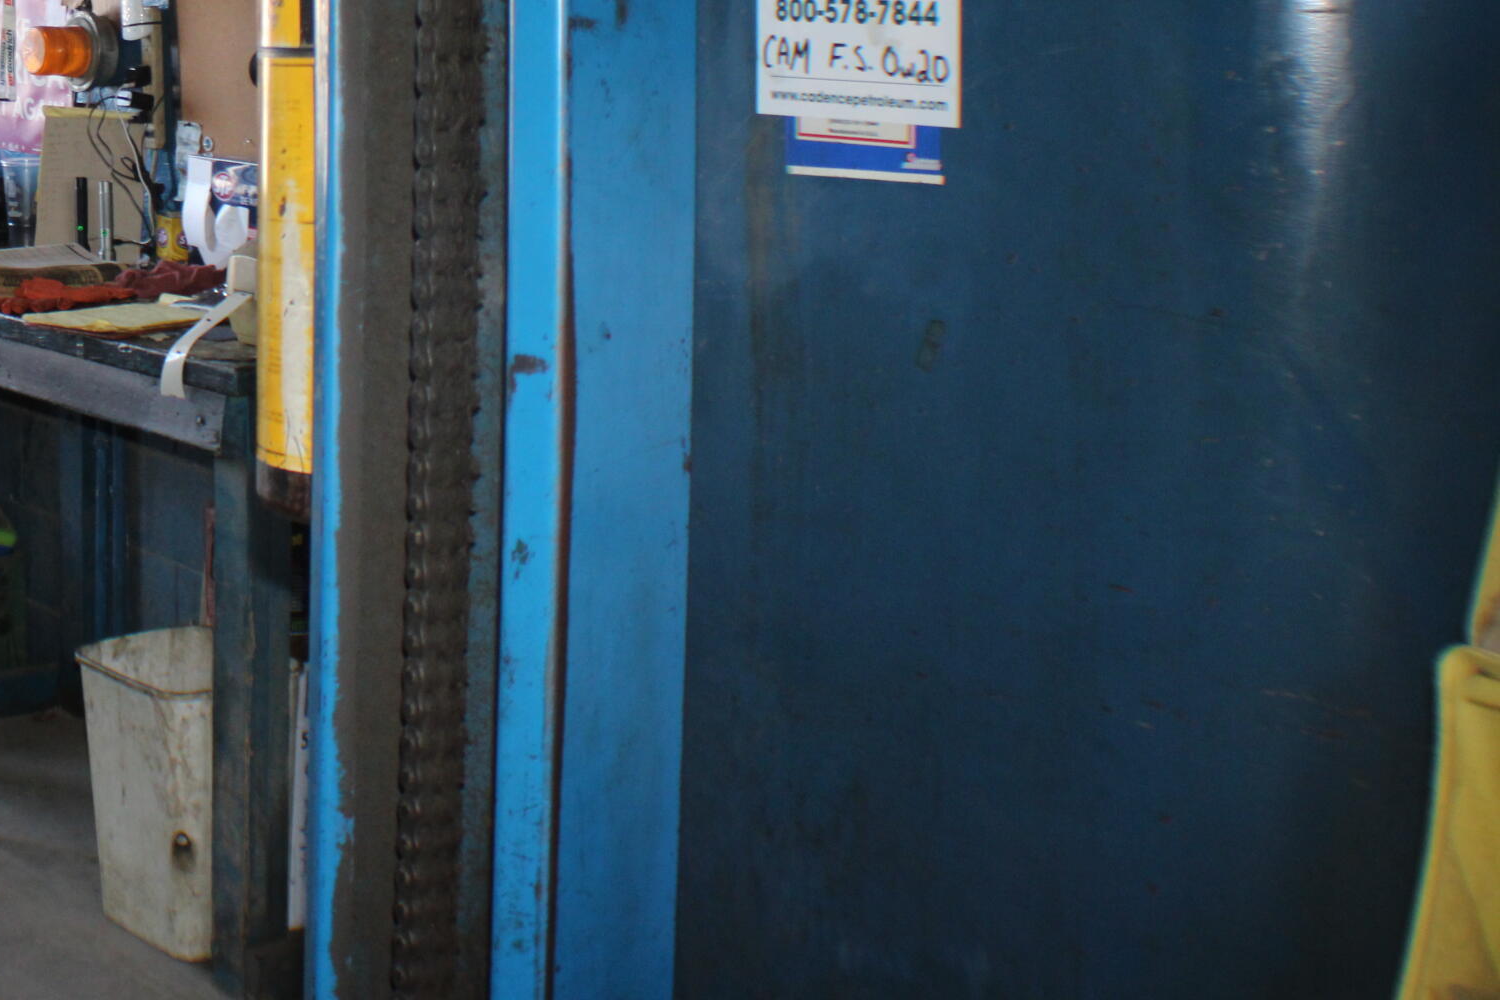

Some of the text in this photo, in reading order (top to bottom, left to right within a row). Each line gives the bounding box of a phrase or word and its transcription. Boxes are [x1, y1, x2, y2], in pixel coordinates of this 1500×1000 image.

[763, 35, 810, 74] CAM
[12, 96, 65, 121] AGA
[771, 90, 948, 111] www.cadencepetroleum.com
